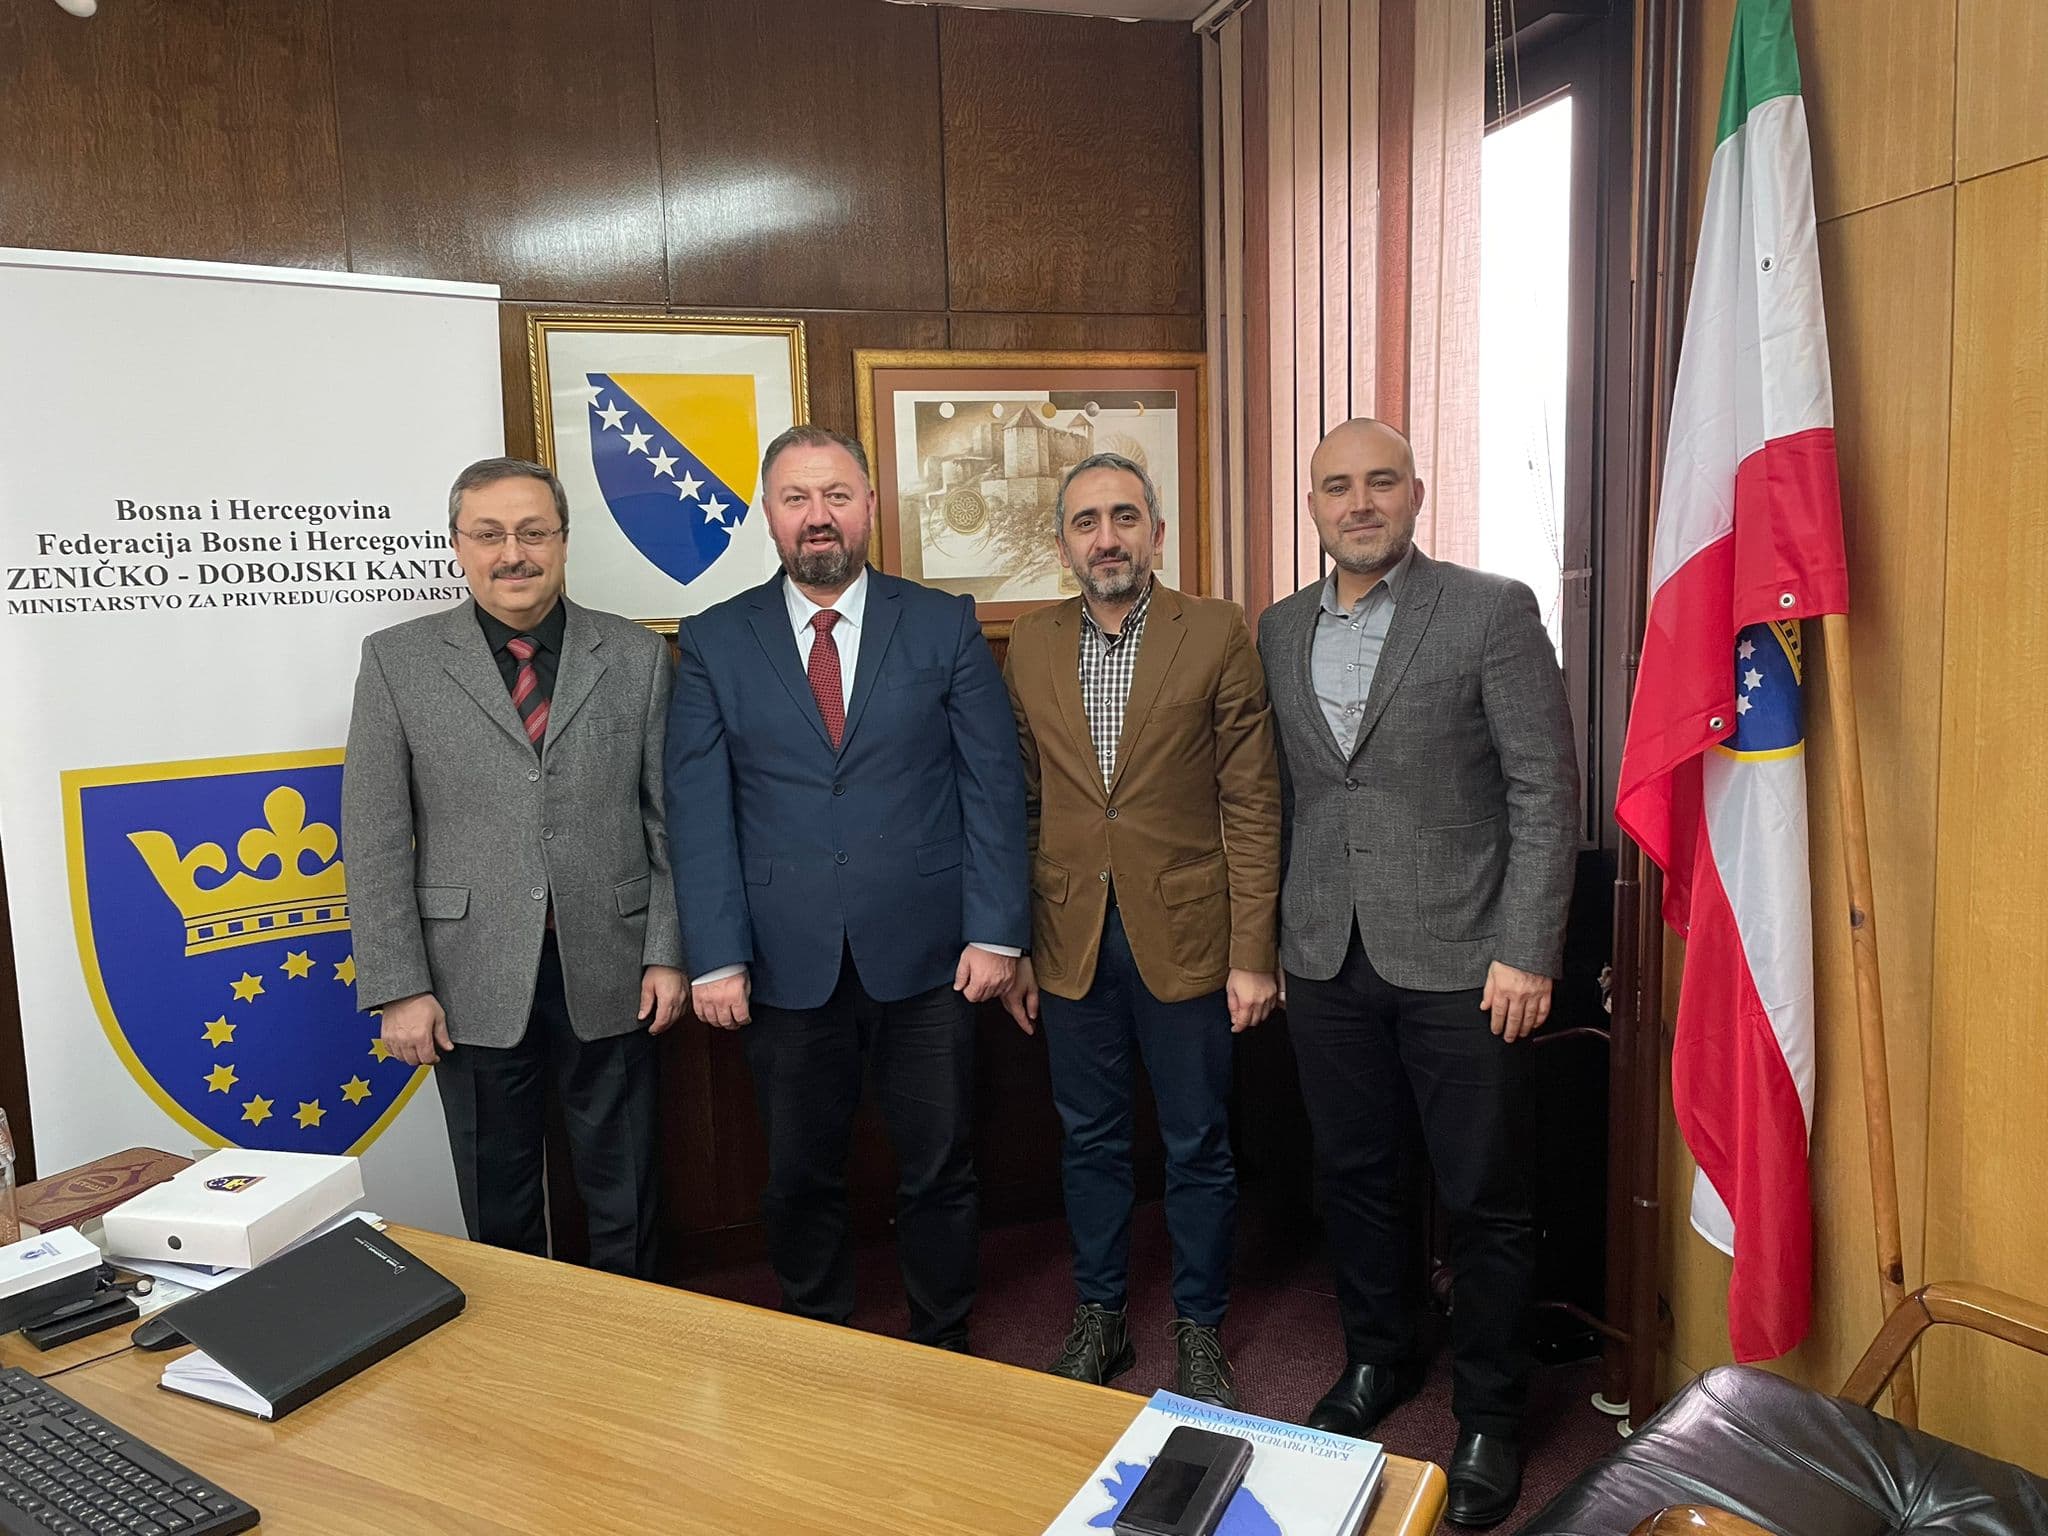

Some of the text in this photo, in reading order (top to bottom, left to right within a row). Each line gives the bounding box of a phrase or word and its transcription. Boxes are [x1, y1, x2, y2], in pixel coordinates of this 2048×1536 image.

[115, 499, 391, 525] Bosna i Hercegovina
[36, 532, 192, 559] Federacija
[202, 531, 282, 552] Bosne
[290, 530, 298, 550] i
[7, 558, 169, 590] ZENIČKO
[199, 561, 355, 585] DOBOJSKI
[8, 594, 182, 615] MINISTARSTVO
[189, 593, 217, 608] ZA
[1167, 1398, 1225, 1424] KANTONA
[1310, 1446, 1350, 1462] KARTA
